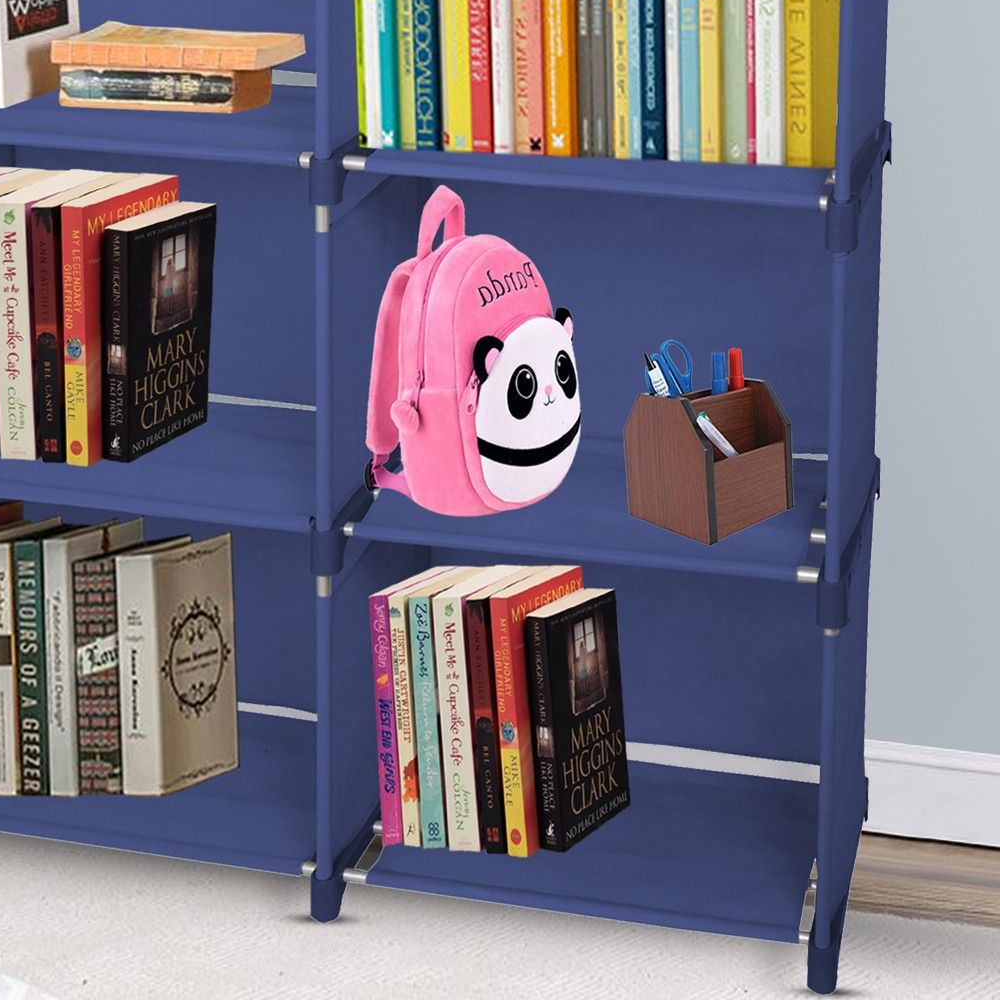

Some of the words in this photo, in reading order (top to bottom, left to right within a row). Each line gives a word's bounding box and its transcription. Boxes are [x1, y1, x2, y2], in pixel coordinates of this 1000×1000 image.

[72, 230, 80, 248] MY
[87, 215, 105, 237] MY
[1, 231, 17, 264] Meet
[4, 267, 17, 282] Me
[72, 249, 81, 314] LEGENDARY
[64, 264, 73, 329] GIRLFRIEND
[2, 297, 23, 350] Cupcake
[112, 311, 121, 344] CLARK
[5, 352, 20, 381] Café
[146, 327, 199, 372] MARY
[75, 371, 85, 404] MIKE
[134, 350, 206, 407] HIGGINS
[7, 387, 18, 441] COLGAN
[44, 385, 54, 422] CANTO
[67, 381, 76, 421] GAYLE
[139, 384, 196, 430] CLARK
[132, 440, 145, 454] NO
[145, 429, 166, 448] PLACE
[166, 421, 182, 438] LIKE
[182, 410, 205, 429] HOME
[18, 560, 36, 654] MEMOIRS
[373, 604, 387, 633] Jenny
[415, 603, 430, 626] Zoë
[511, 604, 526, 624] MY
[374, 635, 388, 668] Colgan
[417, 630, 430, 678] Barnes
[443, 622, 456, 652] Meet
[21, 664, 36, 688] OF
[446, 655, 457, 669] Me
[22, 696, 36, 708] A
[378, 698, 392, 730] WEST
[400, 669, 411, 743] CARTWRIGHT
[447, 683, 464, 735] Cupcake
[569, 707, 615, 753] MARY
[23, 717, 40, 793] GEEZER
[450, 737, 463, 767] Café
[561, 730, 625, 788] HIGGINS
[453, 773, 463, 830] COLGAN
[569, 765, 619, 815] CLARK
[565, 827, 578, 843] NO
[577, 814, 596, 835] PLACE
[595, 805, 609, 823] LIKE
[608, 792, 628, 813] HOME
